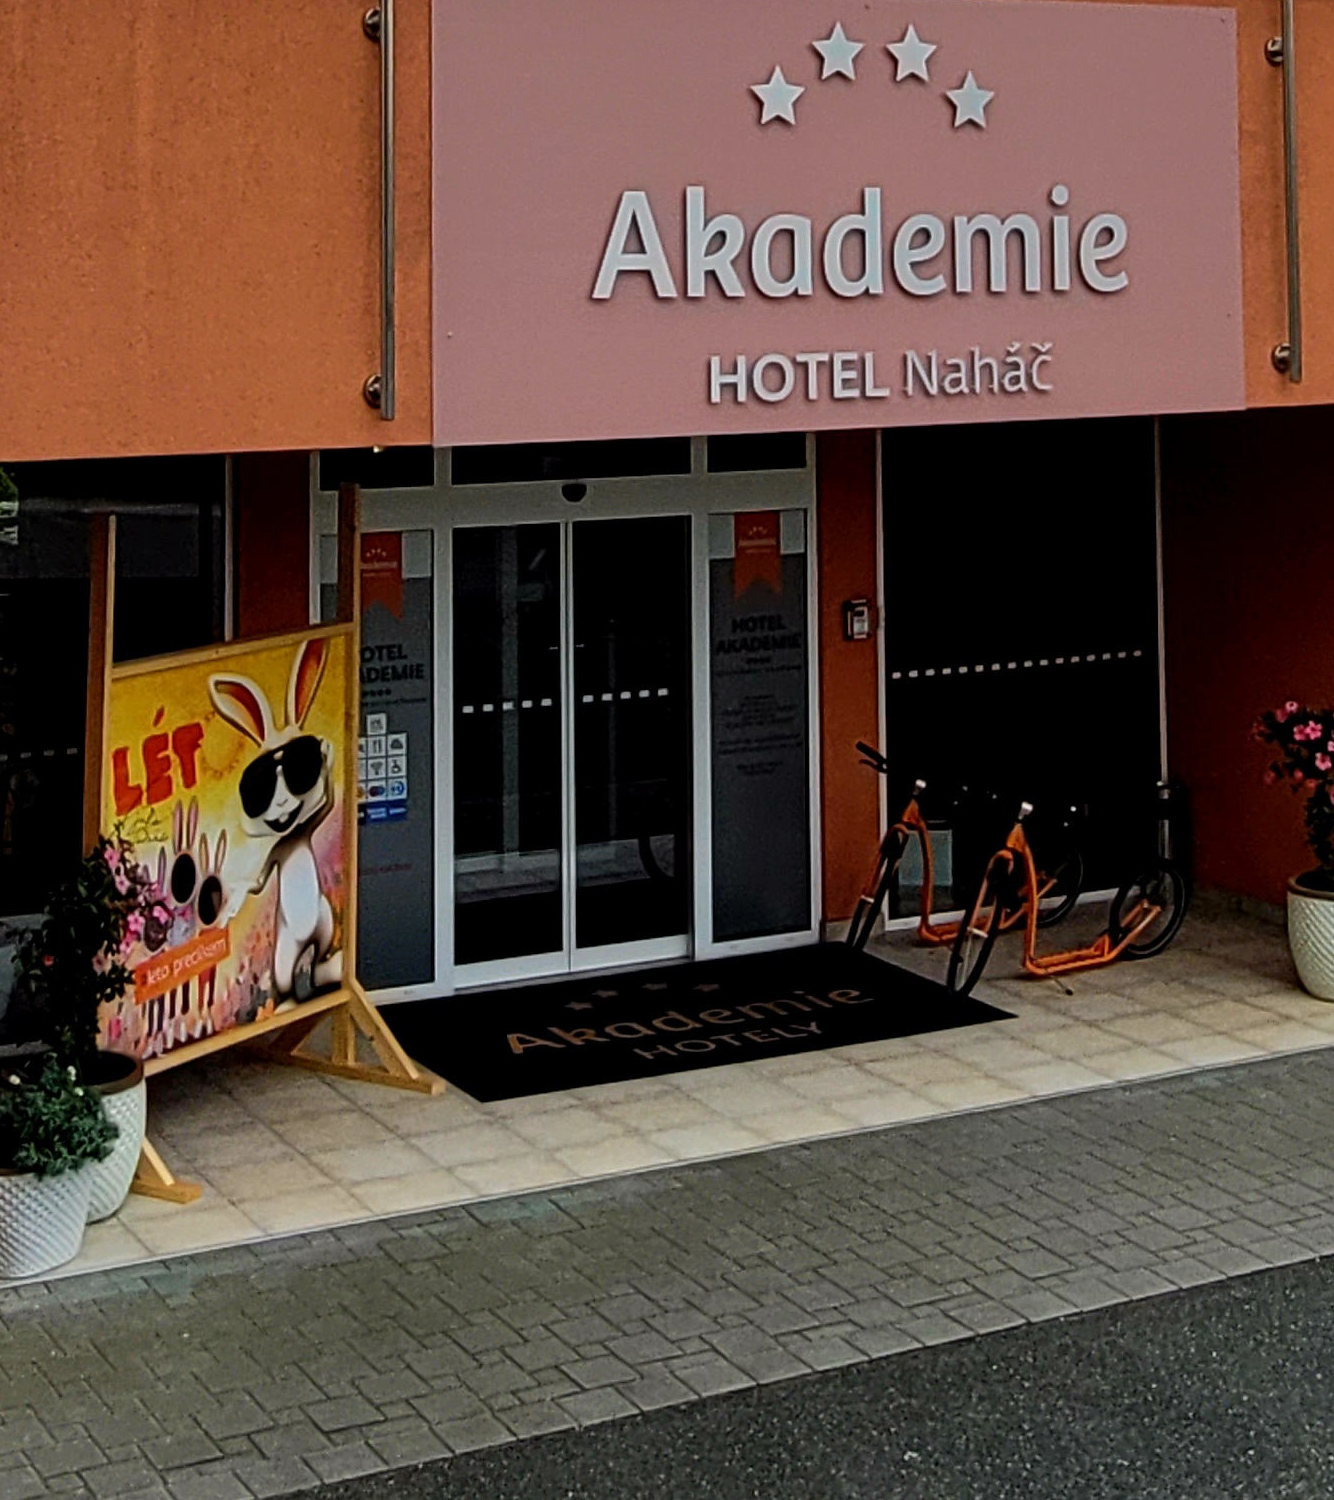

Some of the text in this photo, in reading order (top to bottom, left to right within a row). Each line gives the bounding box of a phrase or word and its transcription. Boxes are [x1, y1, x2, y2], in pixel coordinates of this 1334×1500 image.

[591, 183, 1130, 300] Akademie
[709, 341, 1055, 406] HOTEL Naháč
[730, 613, 787, 633] HOTEL
[359, 644, 408, 664] OTEL
[715, 632, 802, 654] AKADEMIE
[359, 663, 425, 683] DEMIE
[505, 989, 874, 1056] Akademie
[632, 1020, 824, 1061] HOTELY
